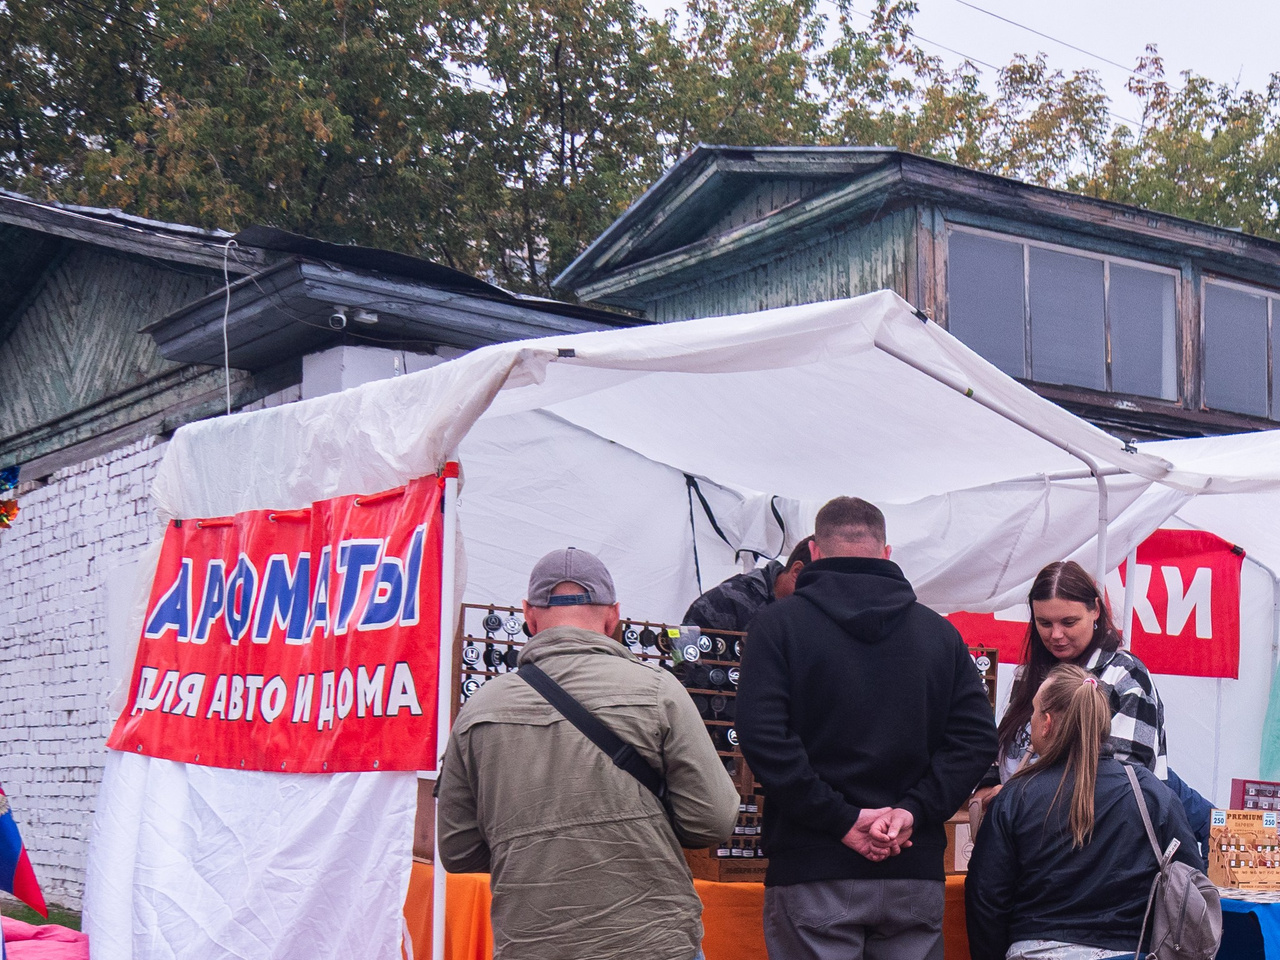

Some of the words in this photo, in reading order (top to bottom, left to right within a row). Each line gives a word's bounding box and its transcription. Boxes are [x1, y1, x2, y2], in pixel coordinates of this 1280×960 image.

[144, 522, 428, 645] АРОМАТЫ
[131, 665, 206, 717] ДЛЯ
[206, 673, 287, 724] АВТО
[292, 673, 315, 724] И
[317, 661, 422, 731] ДОМА
[1213, 817, 1225, 825] 250
[1227, 813, 1262, 821] PREMIUM
[1264, 819, 1276, 827] 250
